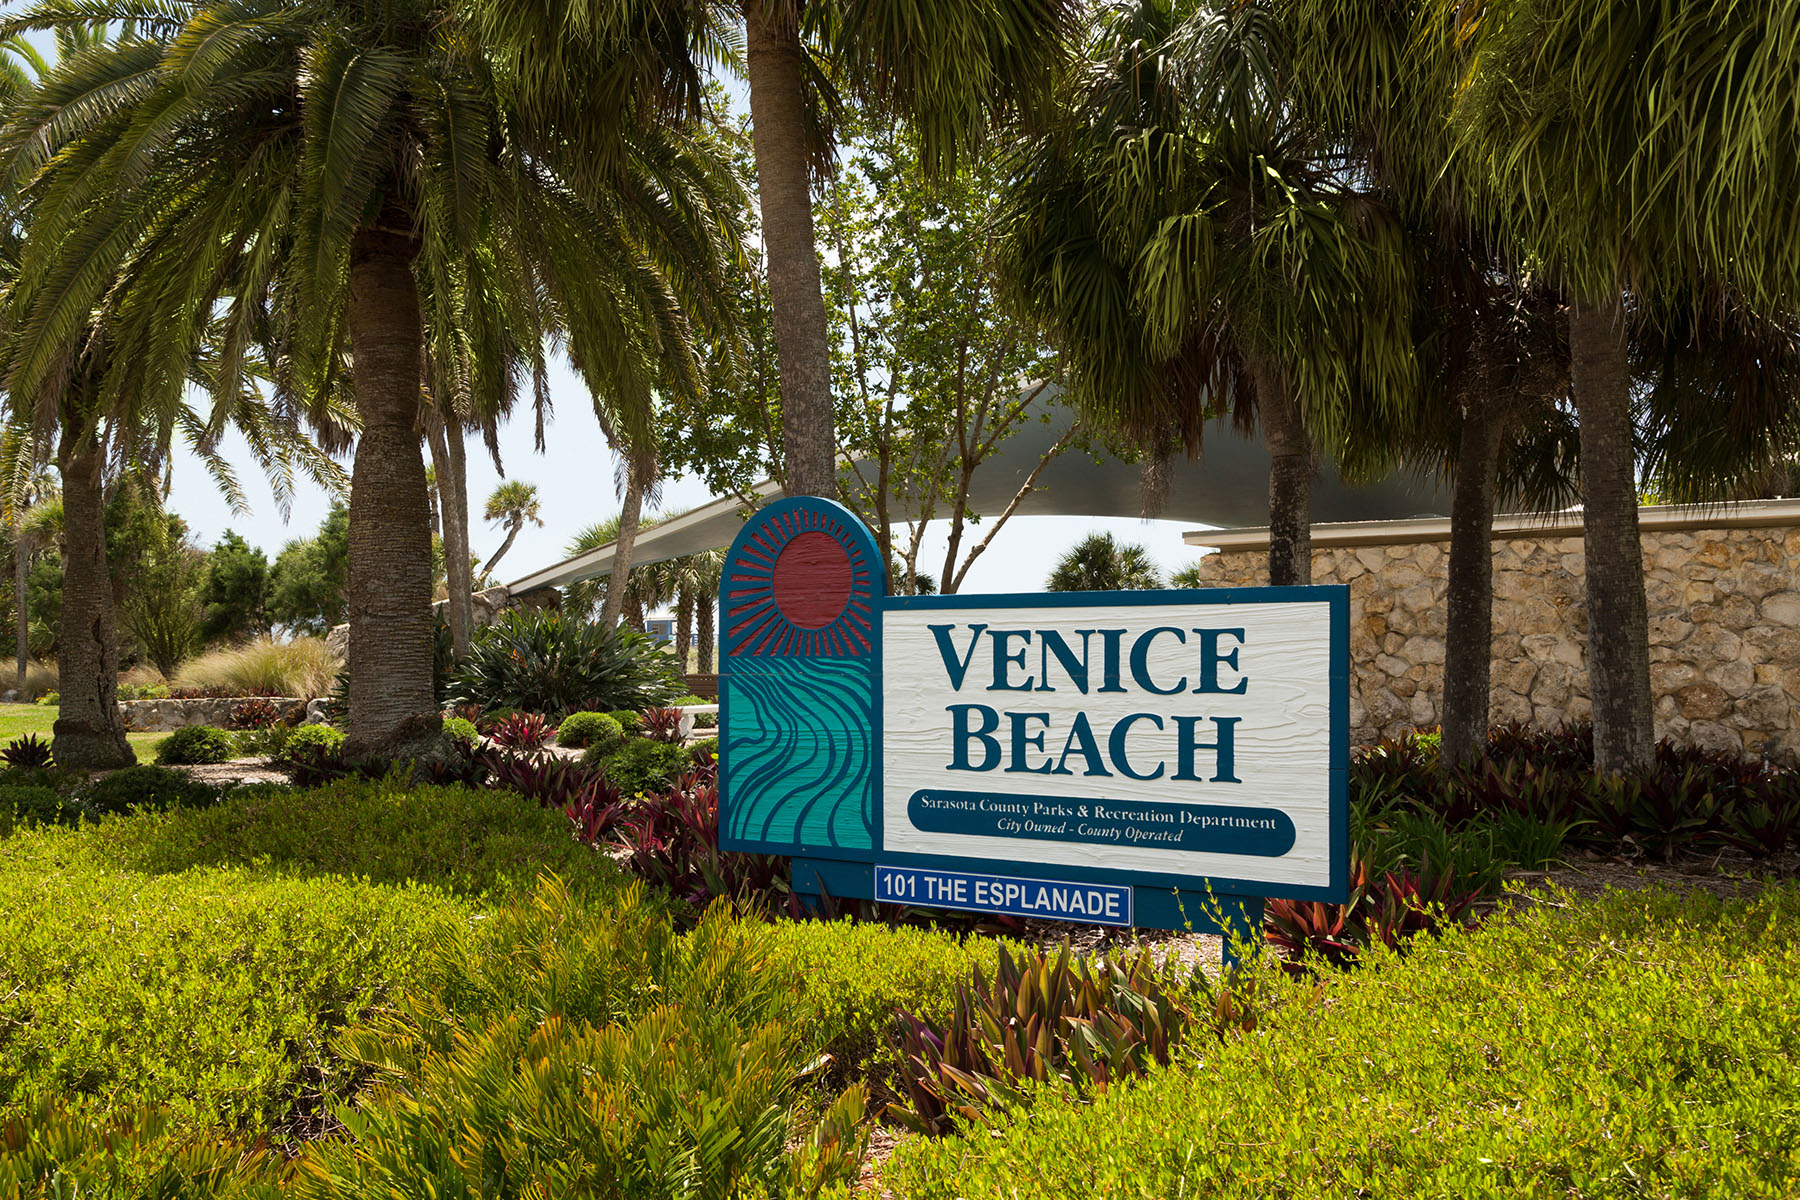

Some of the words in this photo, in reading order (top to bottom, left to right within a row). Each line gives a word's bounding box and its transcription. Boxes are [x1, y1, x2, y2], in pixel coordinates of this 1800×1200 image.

[927, 623, 1248, 695] VENICE
[945, 703, 1242, 784] BEACH
[921, 795, 976, 811] Sarasota
[980, 799, 1029, 817] County
[1033, 802, 1073, 817] Parks
[1077, 805, 1089, 817] &
[1095, 805, 1174, 823] Recreation
[1180, 811, 1276, 830] Department
[997, 818, 1022, 833] City
[1024, 819, 1065, 834] Owned
[1077, 824, 1121, 841] County
[1125, 828, 1183, 843] Operated
[884, 873, 916, 898] 101
[924, 876, 967, 902] THE
[975, 881, 1120, 917] ESPLANADE
